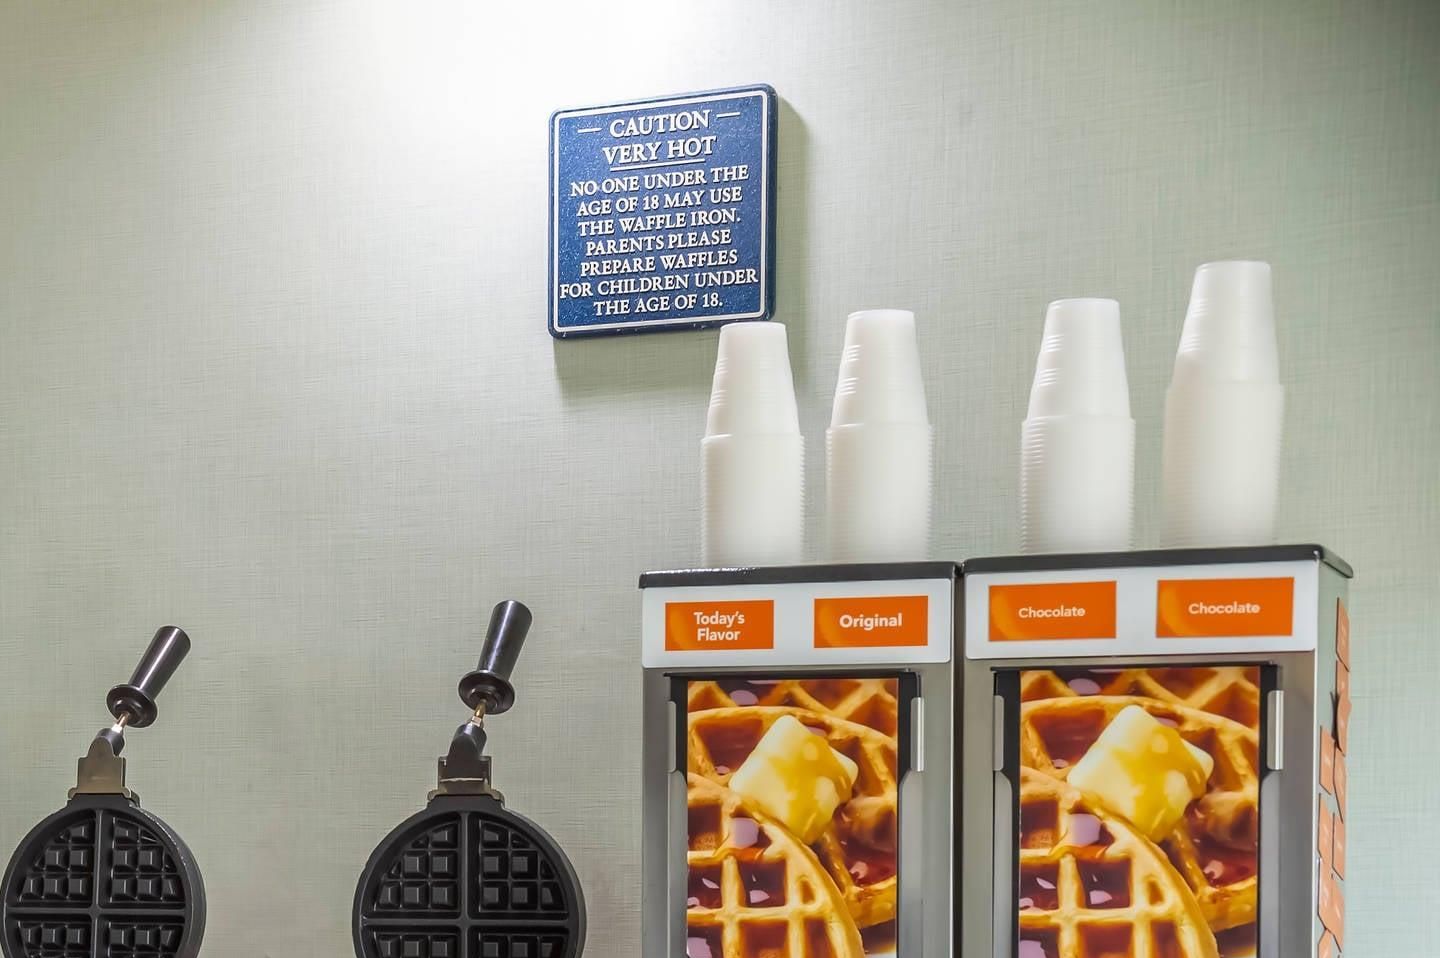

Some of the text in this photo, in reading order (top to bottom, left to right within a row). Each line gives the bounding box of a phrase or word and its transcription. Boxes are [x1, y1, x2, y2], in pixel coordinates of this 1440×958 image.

[610, 110, 710, 138] CAUTION
[602, 135, 717, 165] VERY HOT
[571, 165, 749, 197] NO ONE UNDER THE
[576, 186, 742, 217] AGE OF 18 MAY USE
[578, 207, 741, 237] THE WAFFLE IRON.
[585, 229, 732, 257] PARENTS PLEASE
[580, 249, 738, 277] PREPARE WAFFLES
[559, 268, 758, 299] FOR CHILDREN UNDER
[593, 292, 723, 316] THE AGE OF 18.
[693, 611, 745, 628] Today's
[839, 612, 903, 631] Original
[1018, 605, 1086, 619] Chocolate
[1188, 601, 1260, 615] Chocolate
[697, 627, 741, 641] Flavor
